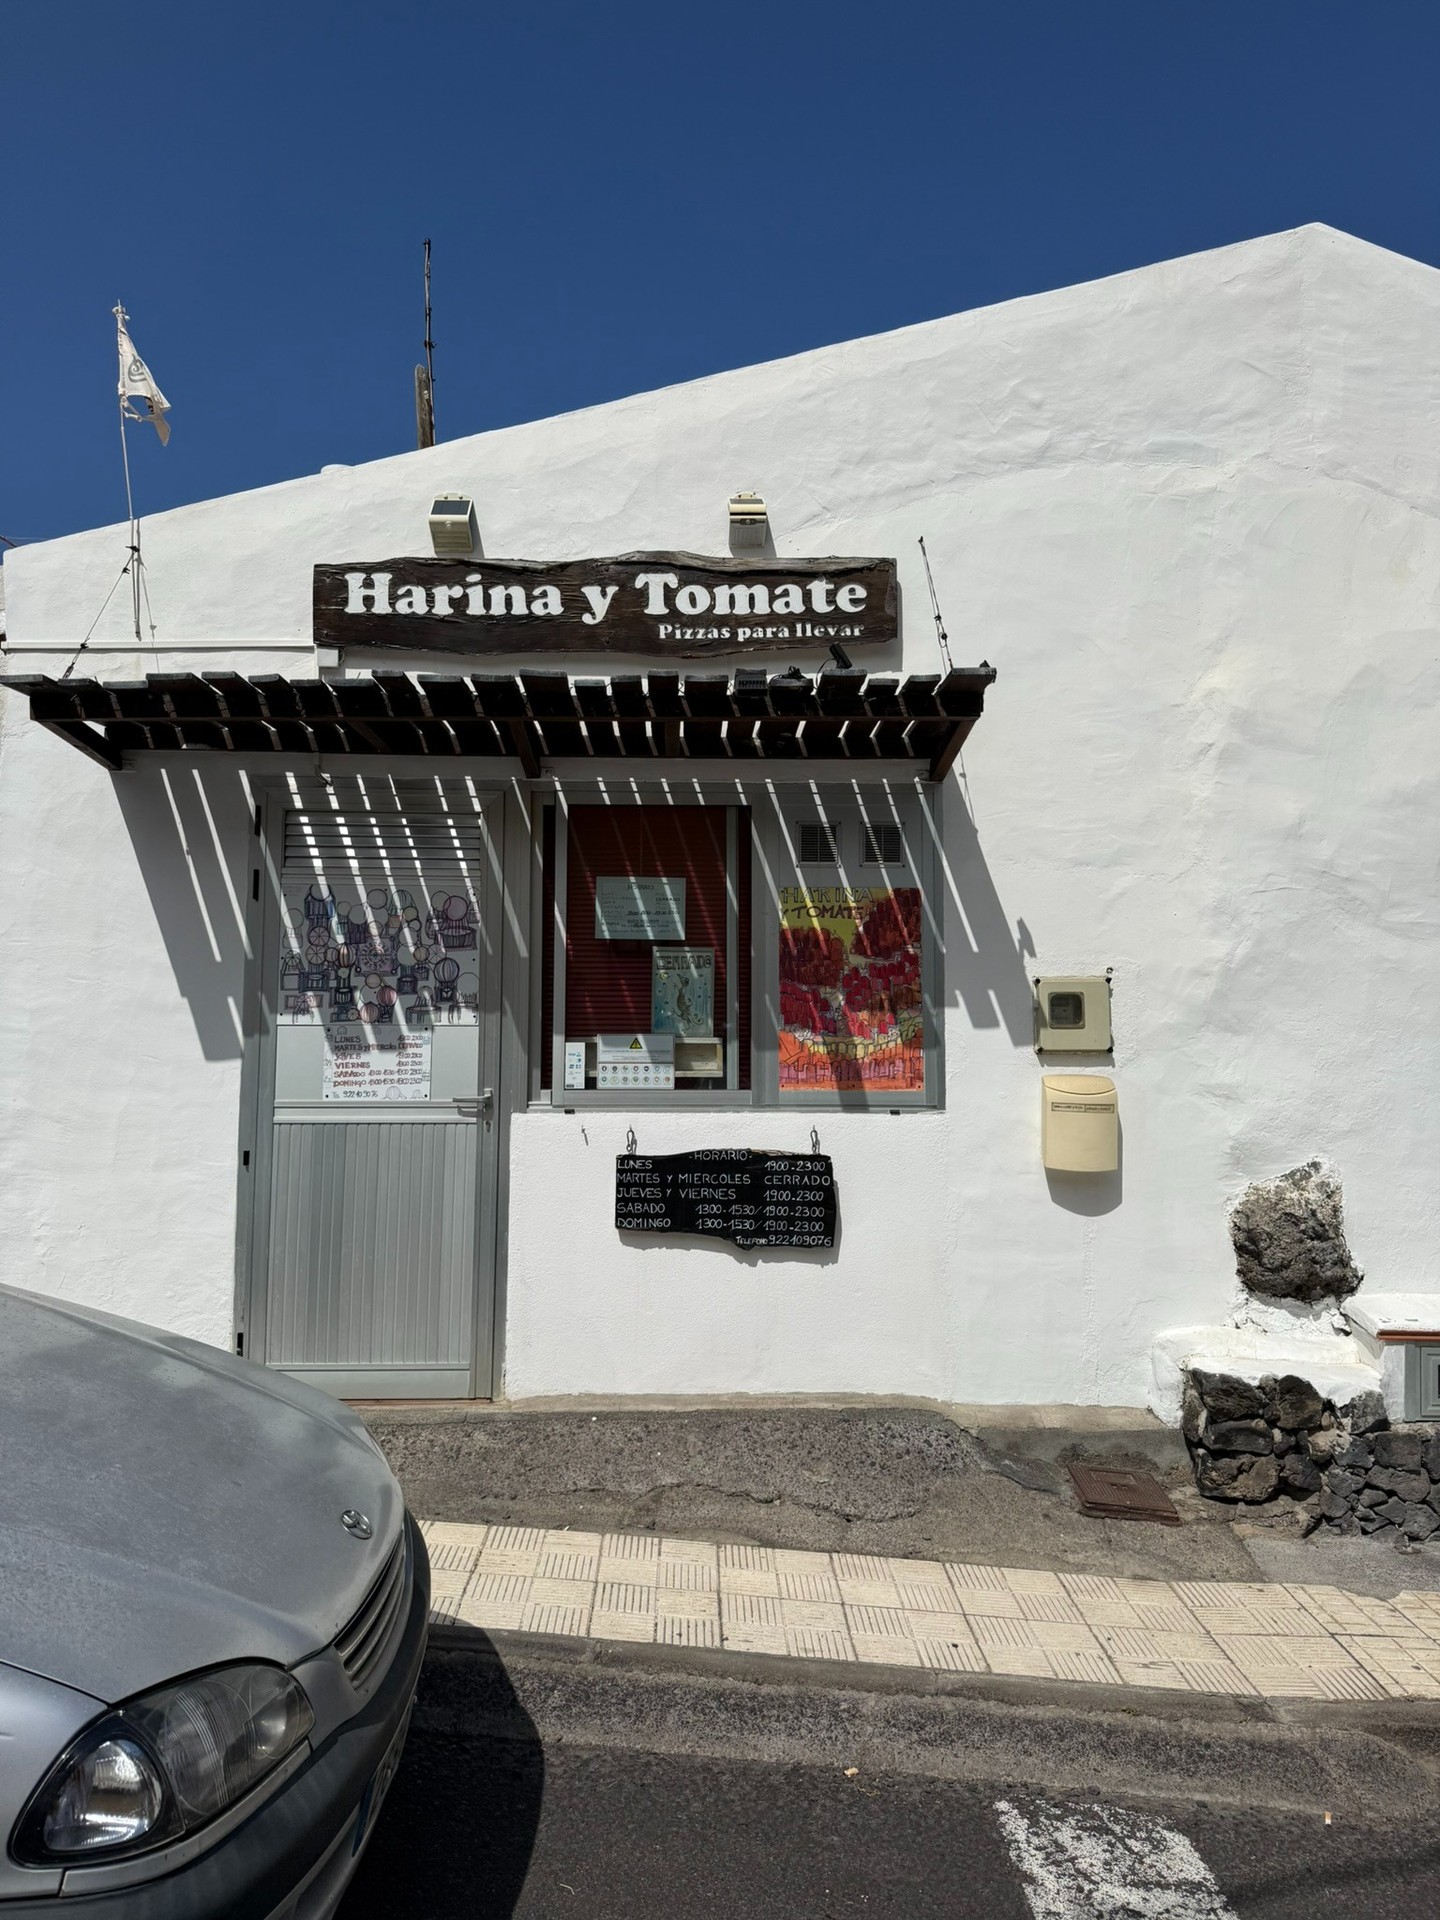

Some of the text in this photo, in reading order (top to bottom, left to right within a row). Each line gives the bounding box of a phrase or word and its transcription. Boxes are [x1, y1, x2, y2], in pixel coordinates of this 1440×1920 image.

[344, 572, 868, 625] Harina y Tomate
[658, 622, 866, 642] Pizzas para llevar
[783, 887, 874, 904] HARINA
[790, 904, 865, 920] TOMATE
[617, 1160, 653, 1169] LUNES
[616, 1173, 660, 1183] MARTES
[678, 1173, 751, 1185] MIERCOLES
[764, 1174, 831, 1186] CERRADO
[616, 1187, 662, 1198] JUEVES
[679, 1188, 737, 1200] VIERNES
[616, 1202, 666, 1213] SABADO
[617, 1217, 671, 1228] DOMINGO
